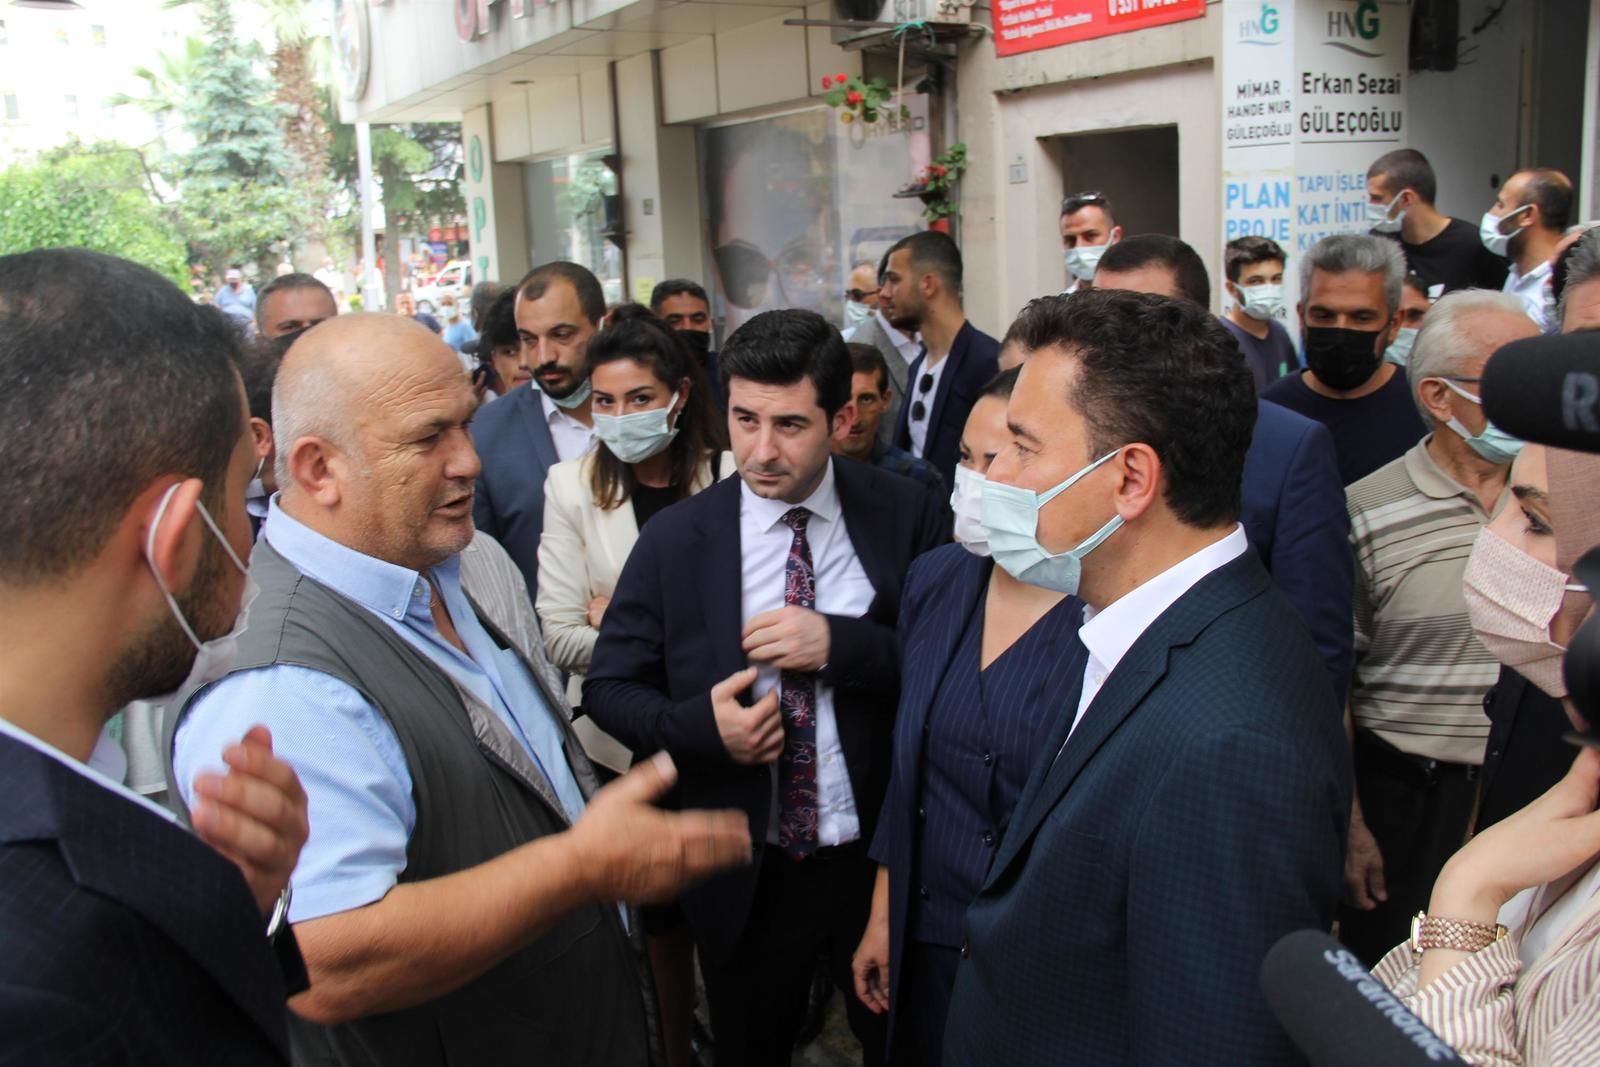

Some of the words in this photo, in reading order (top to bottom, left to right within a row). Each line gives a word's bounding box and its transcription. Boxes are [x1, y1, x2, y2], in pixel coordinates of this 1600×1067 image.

[1328, 0, 1380, 40] HNG
[1237, 79, 1281, 99] MİMAR
[1302, 72, 1353, 94] Erkan
[1358, 73, 1401, 94] Sezai
[1227, 102, 1264, 119] HANDE
[1268, 100, 1291, 114] NUR
[1300, 105, 1402, 136] GÜLEÇOĞLU
[1227, 121, 1292, 140] GÜLEÇOĞLU
[1297, 175, 1332, 192] TAPU
[1336, 170, 1367, 192] İŞLE
[1226, 181, 1290, 210] PLAN
[1298, 203, 1330, 225] KAT
[1226, 218, 1290, 241] PROJE
[1324, 949, 1455, 1061] Saramonic
